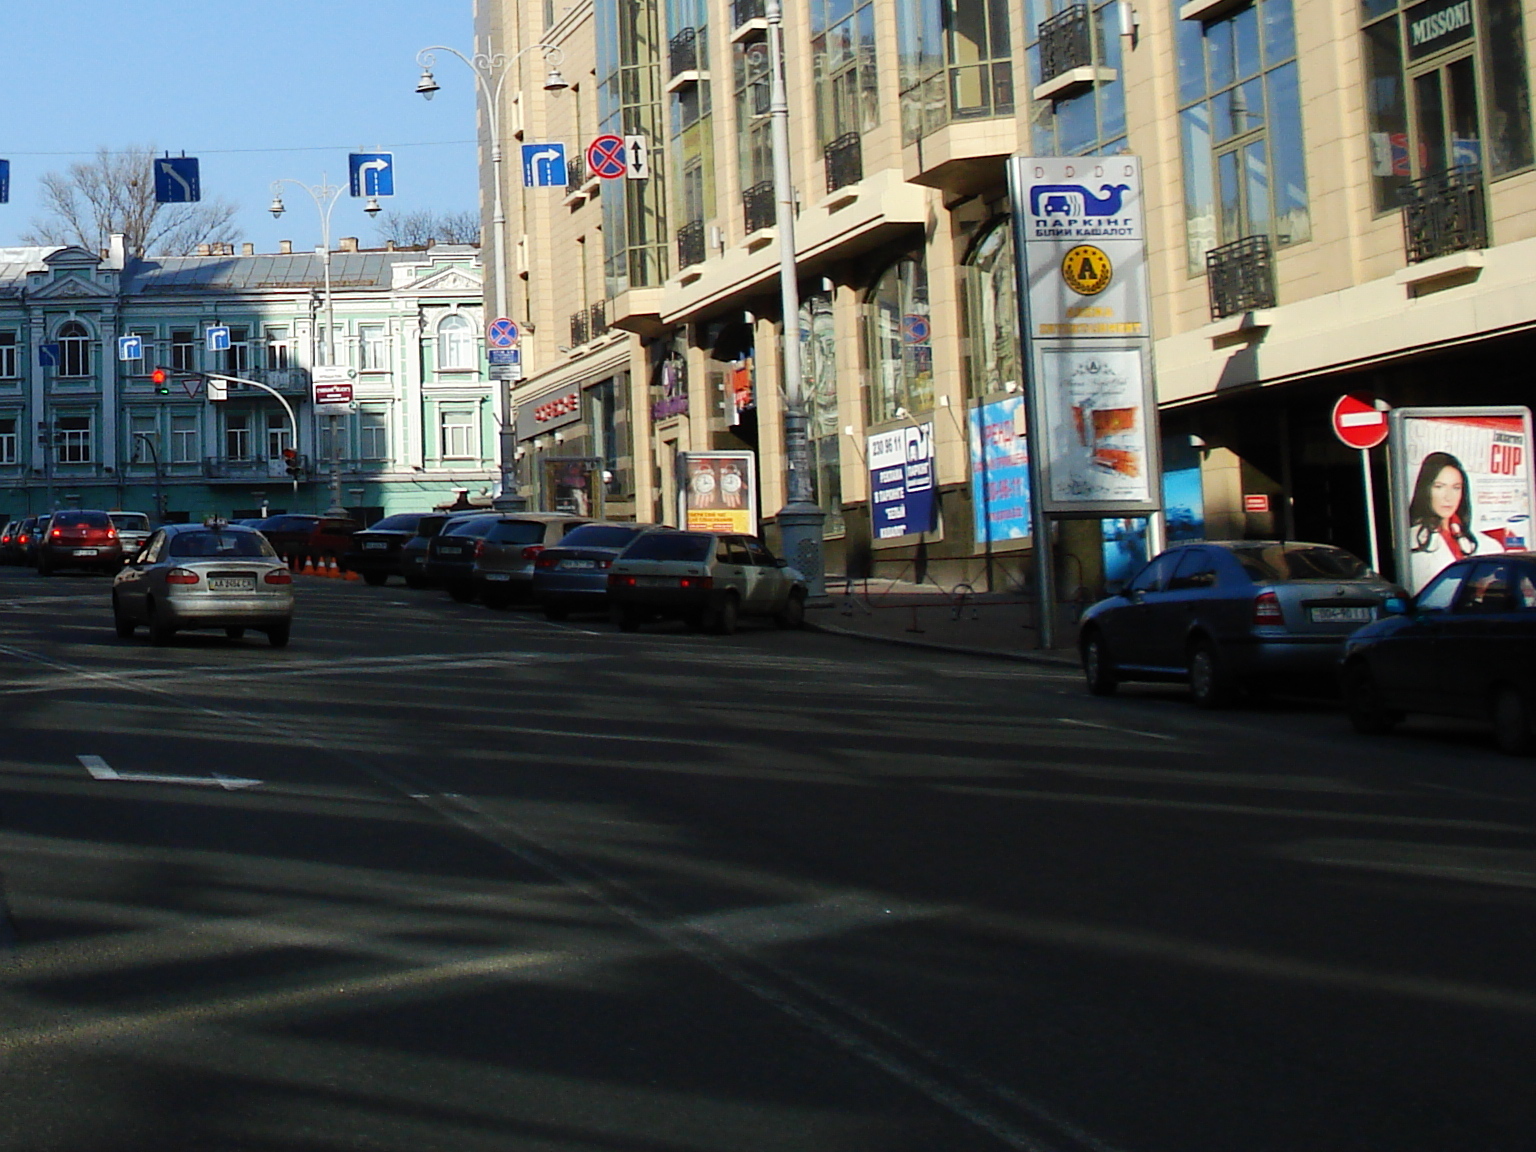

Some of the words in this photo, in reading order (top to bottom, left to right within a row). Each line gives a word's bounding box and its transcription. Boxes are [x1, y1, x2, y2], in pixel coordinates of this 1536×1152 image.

[1411, 0, 1471, 46] MISSONI
[1035, 218, 1133, 228] ПАРКІНГ
[1075, 227, 1134, 237] КАШАЛОТ
[1077, 256, 1099, 280] A
[872, 439, 884, 457] 230
[885, 437, 893, 454] 96
[894, 435, 902, 452] 11
[1490, 444, 1522, 476] CUP
